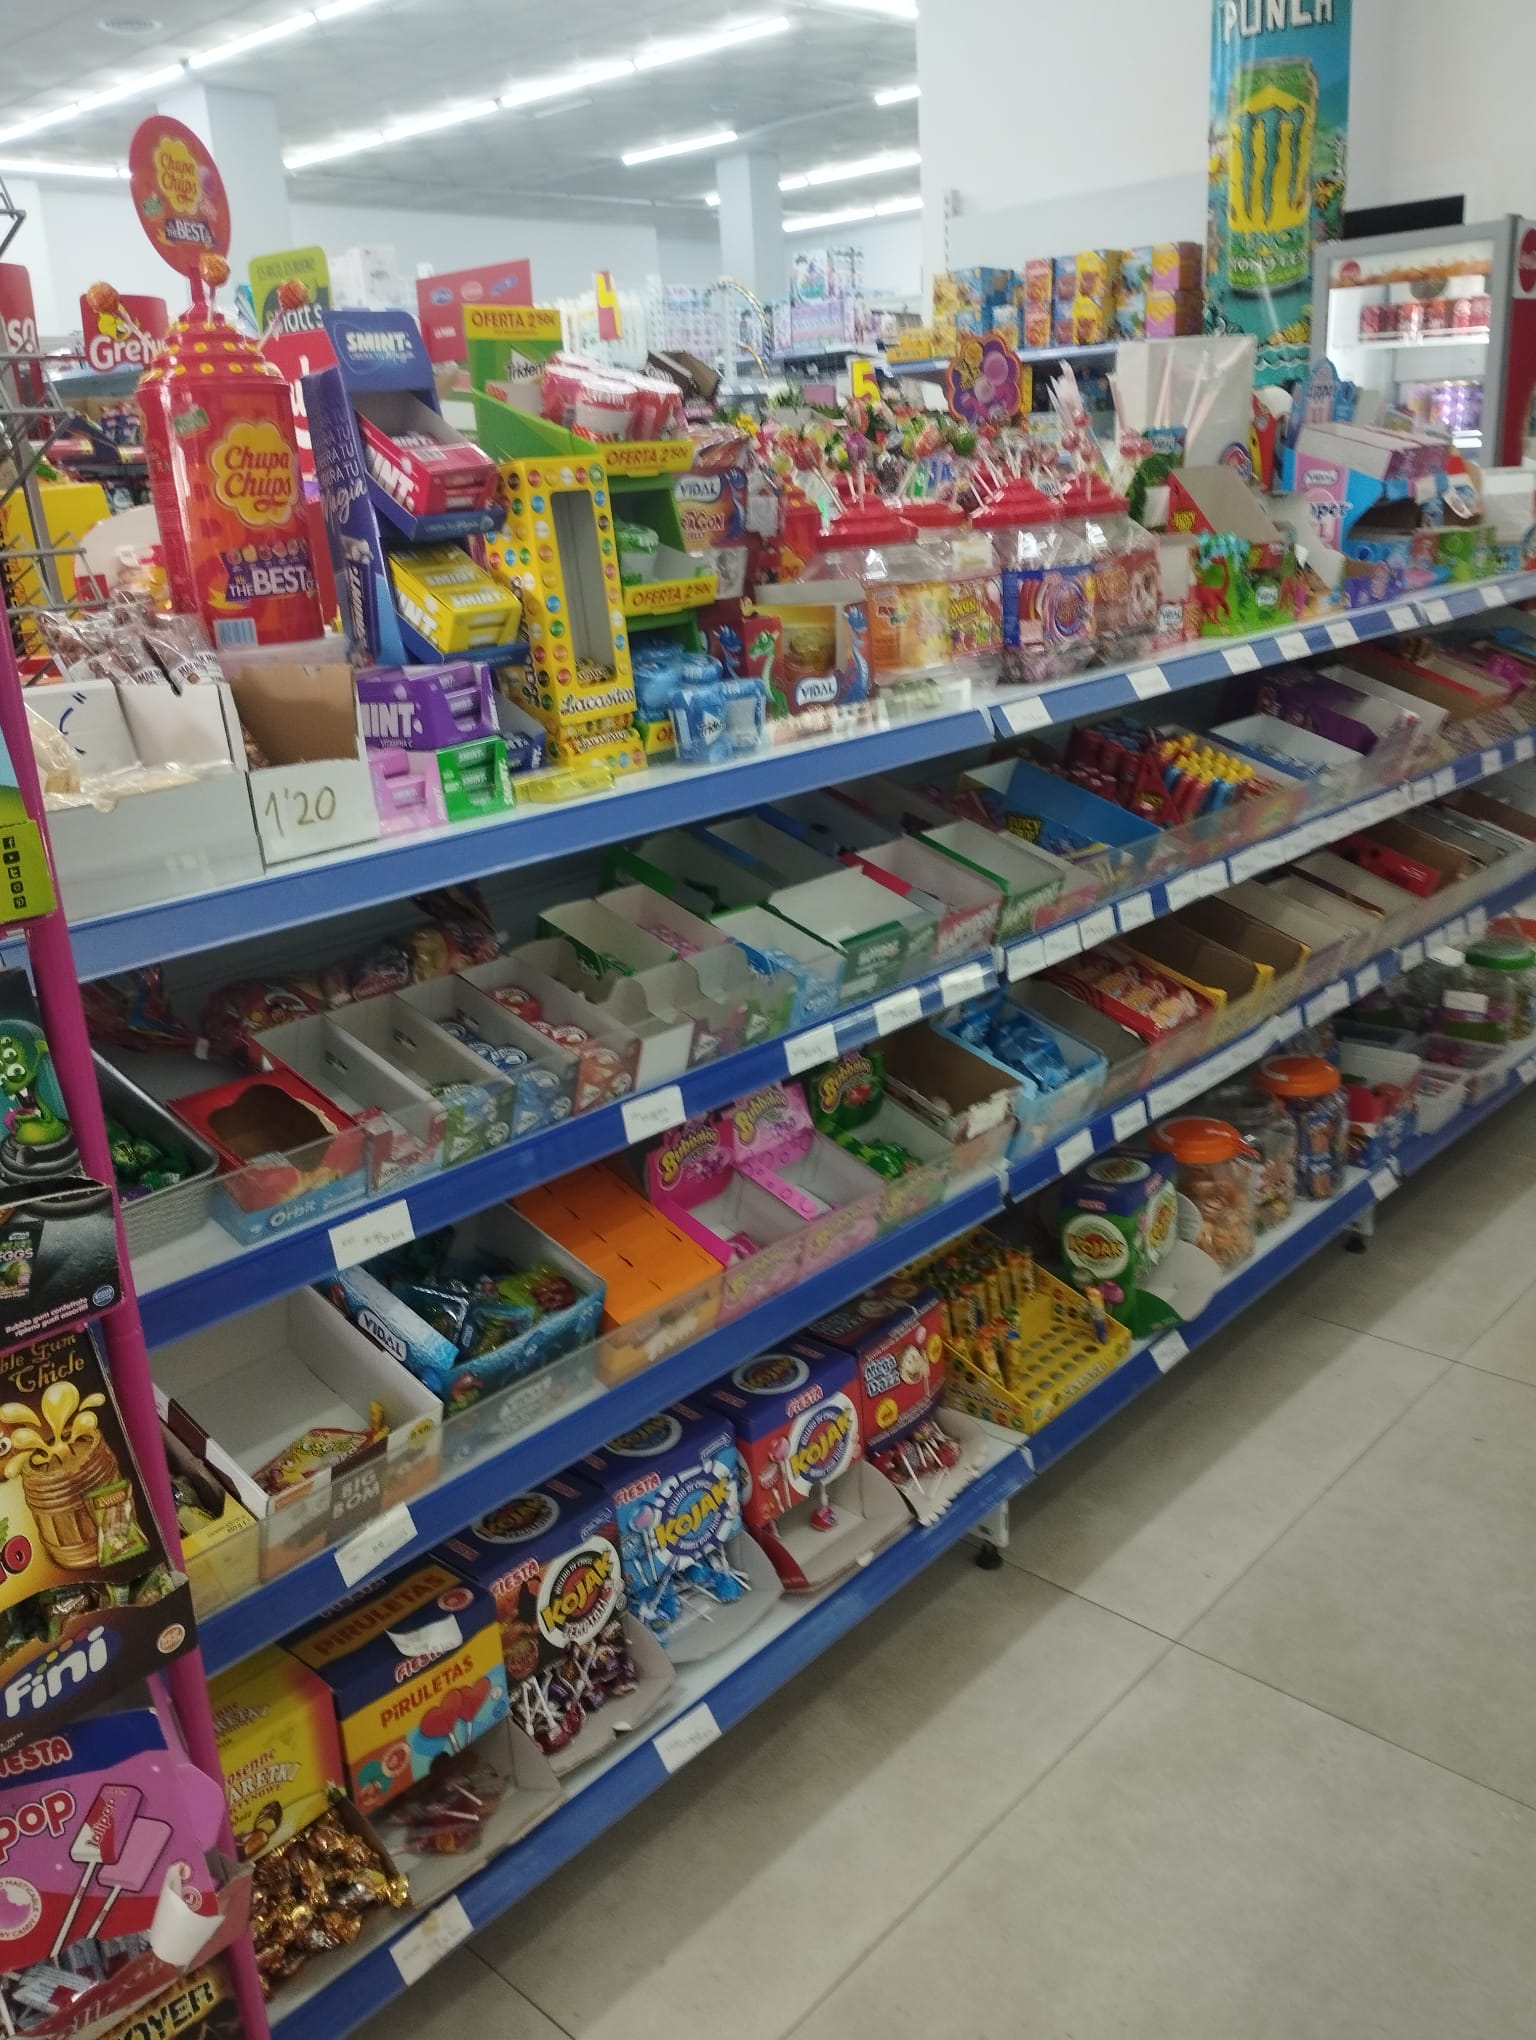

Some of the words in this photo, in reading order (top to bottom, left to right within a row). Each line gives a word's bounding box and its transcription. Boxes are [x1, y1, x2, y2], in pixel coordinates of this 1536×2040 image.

[472, 311, 526, 328] OFERTA
[345, 331, 405, 352] SMINT
[224, 447, 290, 476] Chupa
[606, 451, 658, 466] OFERTA
[224, 471, 292, 500] Chups
[680, 482, 717, 497] VIDAL
[229, 584, 254, 598] THE
[251, 566, 307, 596] BEST
[632, 586, 682, 605] OFERTA
[801, 684, 836, 697] VIDAL
[363, 1313, 405, 1361] VIDAL
[0, 1353, 25, 1374] ble
[789, 1409, 852, 1477] KOJAK
[655, 1477, 731, 1548] KOJAK
[490, 1557, 541, 1600] FIESTA
[540, 1547, 614, 1633] KOJAK
[313, 1573, 446, 1656] PIRULETAS
[4, 1625, 108, 1718] Fini
[379, 1655, 474, 1729] PIRULETAS
[0, 1790, 77, 1866] POP
